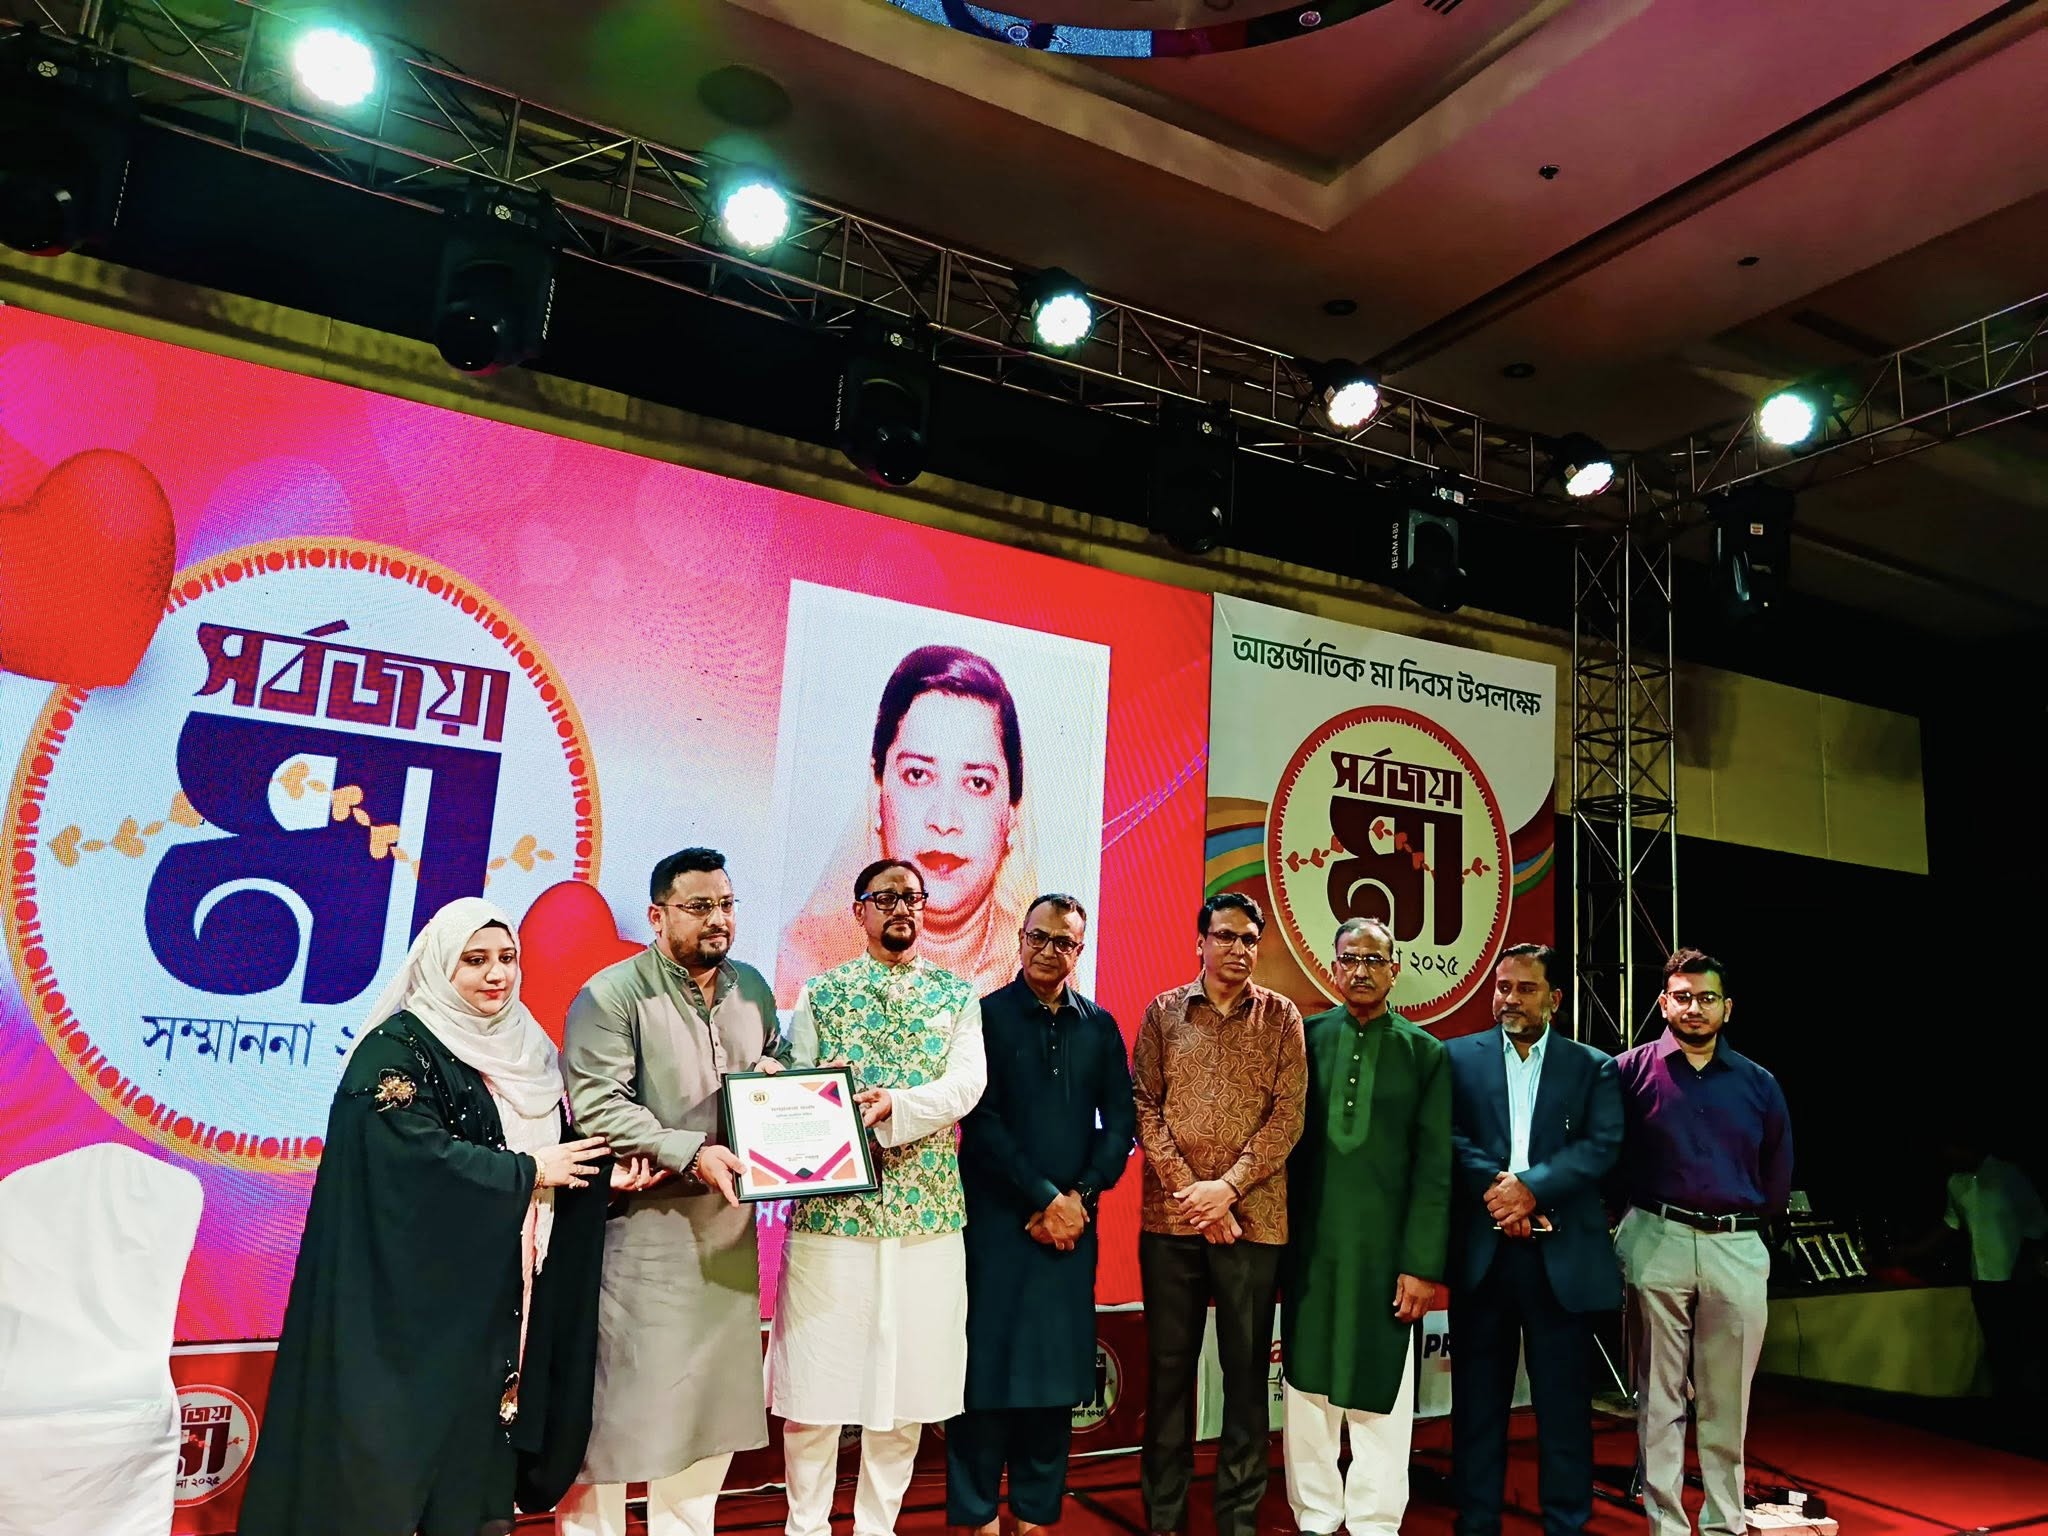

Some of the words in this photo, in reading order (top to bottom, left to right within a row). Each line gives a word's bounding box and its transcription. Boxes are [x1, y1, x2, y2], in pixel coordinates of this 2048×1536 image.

[194, 619, 511, 743] সর্বজয়া
[1232, 633, 1365, 682] আন্তর্জাতিক
[1370, 662, 1394, 689] মা
[1398, 659, 1452, 700] দিবস
[1458, 671, 1541, 716] উপলক্ষে
[1331, 747, 1463, 810] সর্বজয়া
[1327, 795, 1463, 946] মা
[1409, 953, 1459, 977] ২০২৫
[141, 1014, 317, 1067] সম্মাননা
[192, 1476, 221, 1488] ২০২৫
